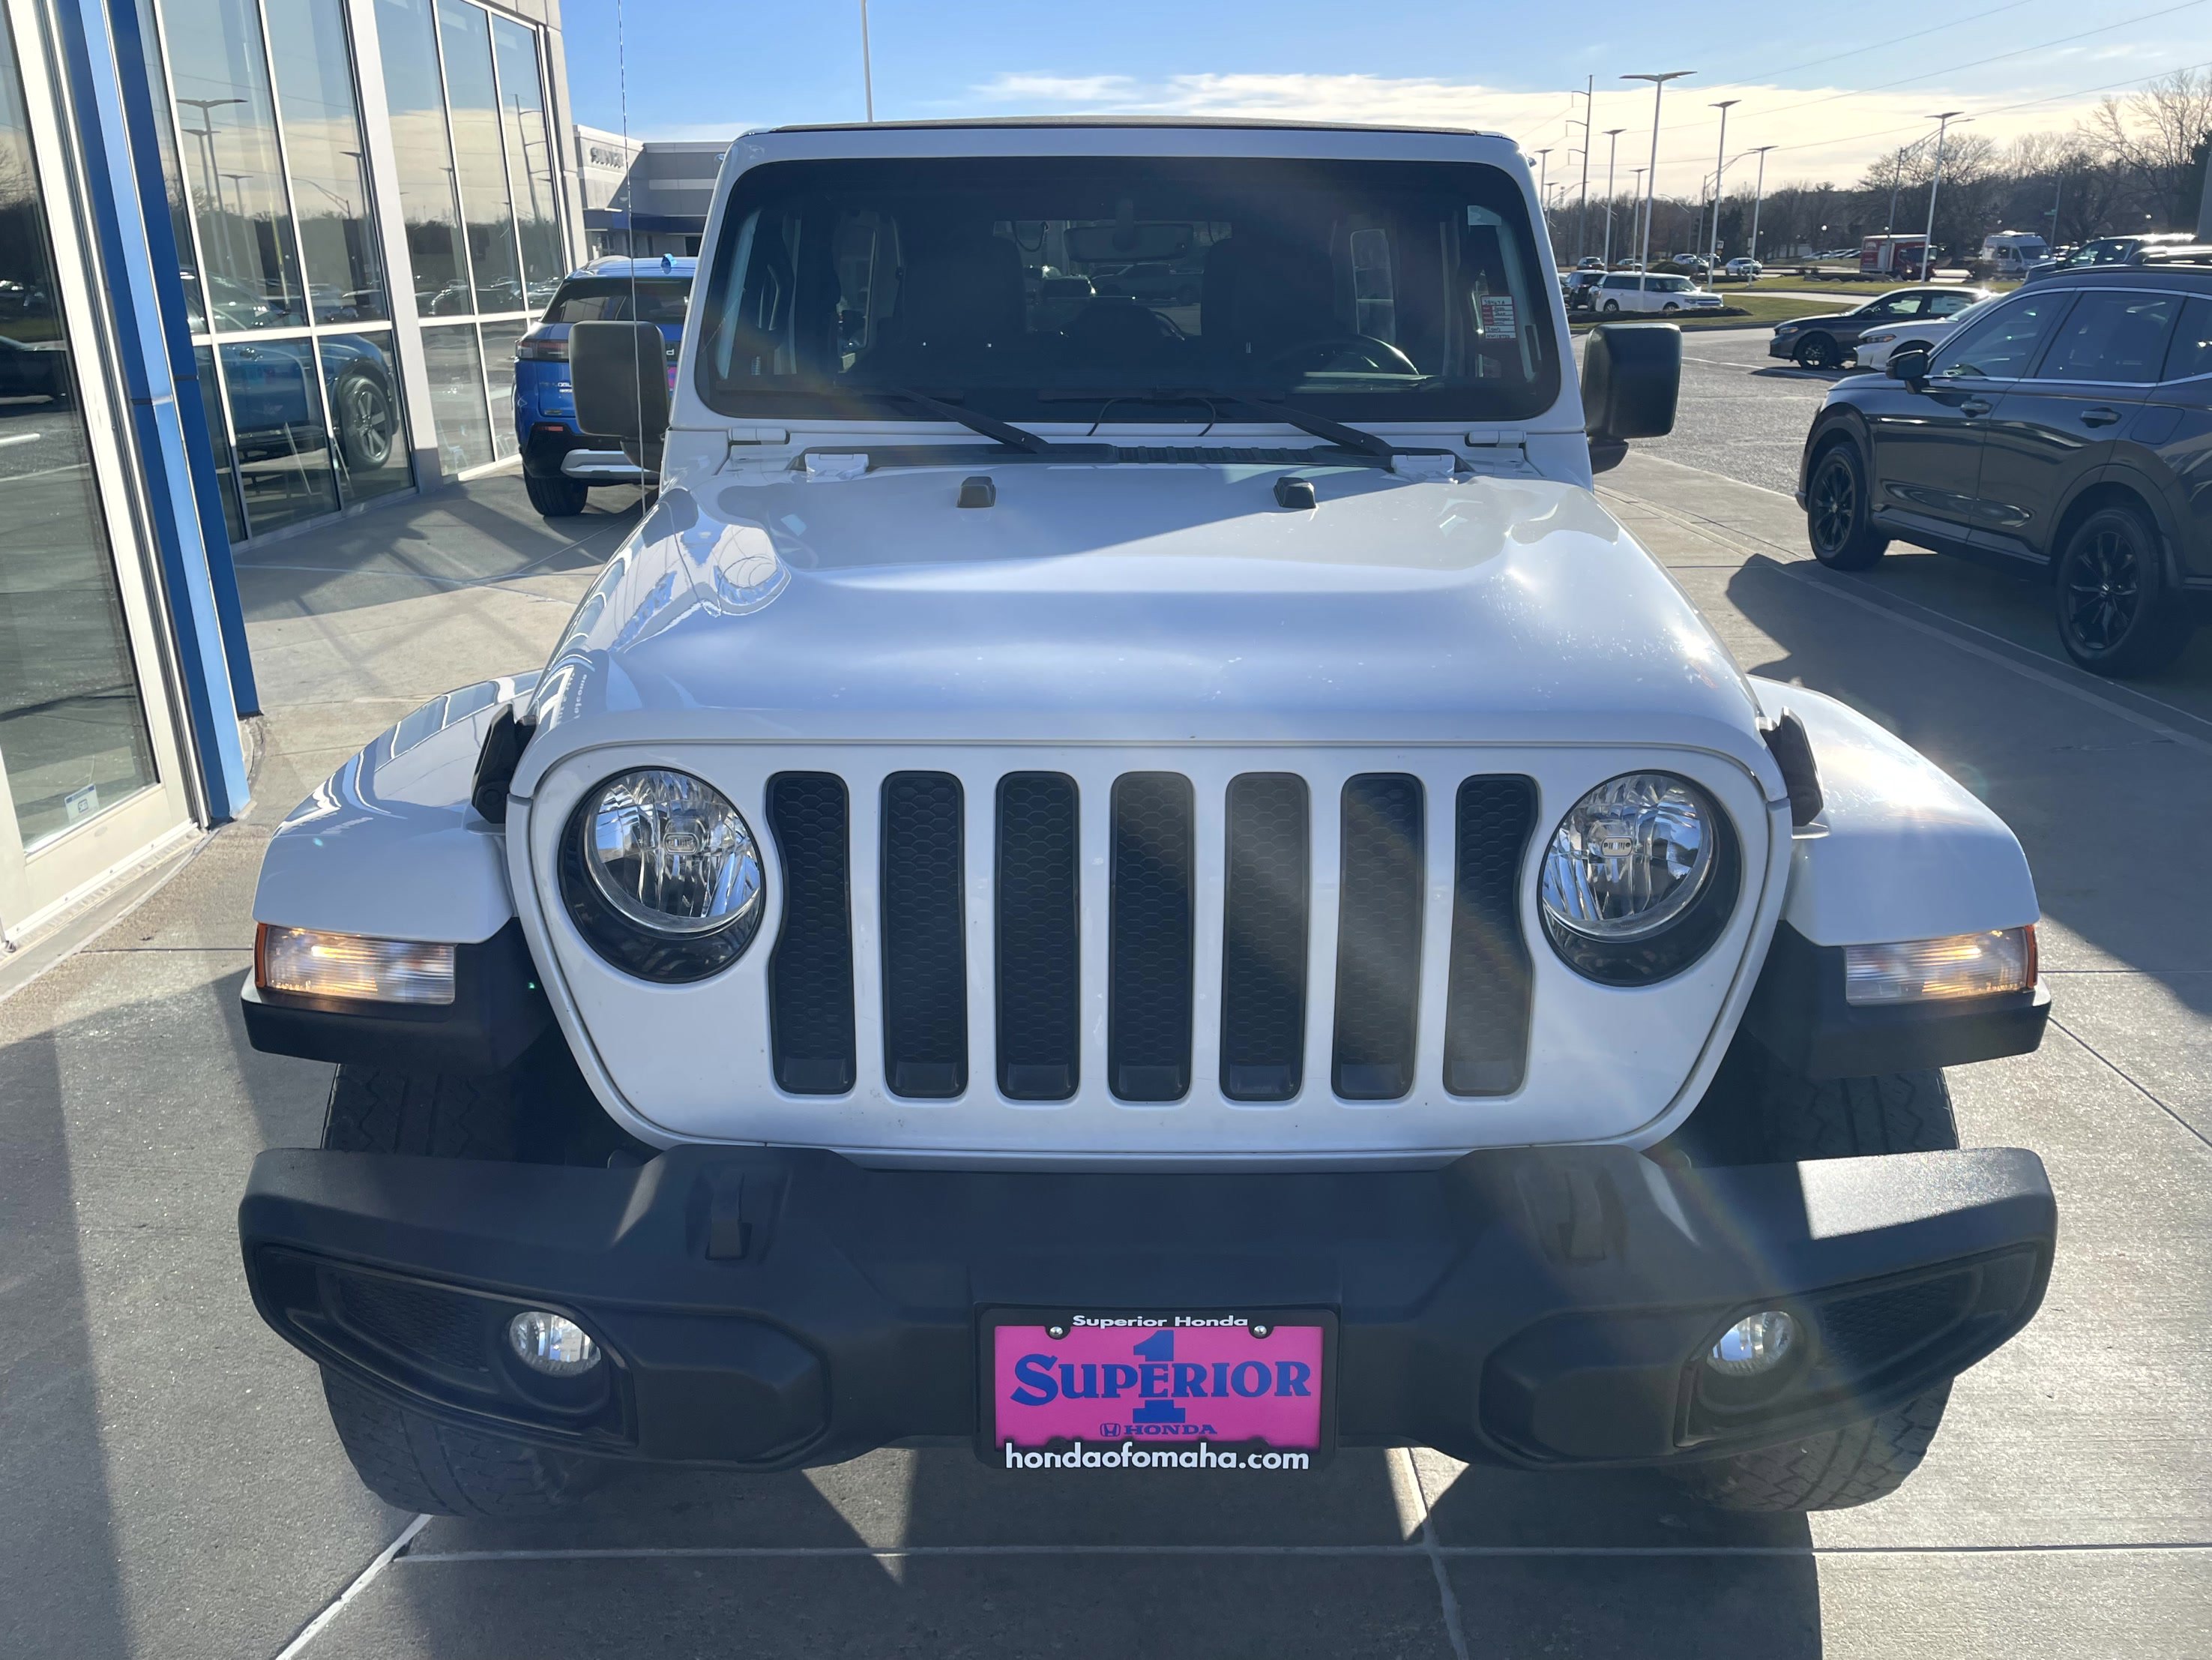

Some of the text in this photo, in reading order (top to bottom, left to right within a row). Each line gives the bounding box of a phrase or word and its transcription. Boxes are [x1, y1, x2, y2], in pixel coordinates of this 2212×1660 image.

[1072, 1314, 1248, 1329] Superior Honda
[1010, 1353, 1311, 1407] SUPERIOR
[1133, 1329, 1186, 1424] 1
[1124, 1424, 1217, 1436] HONDA
[1005, 1442, 1310, 1470] hondaofomaha.com
